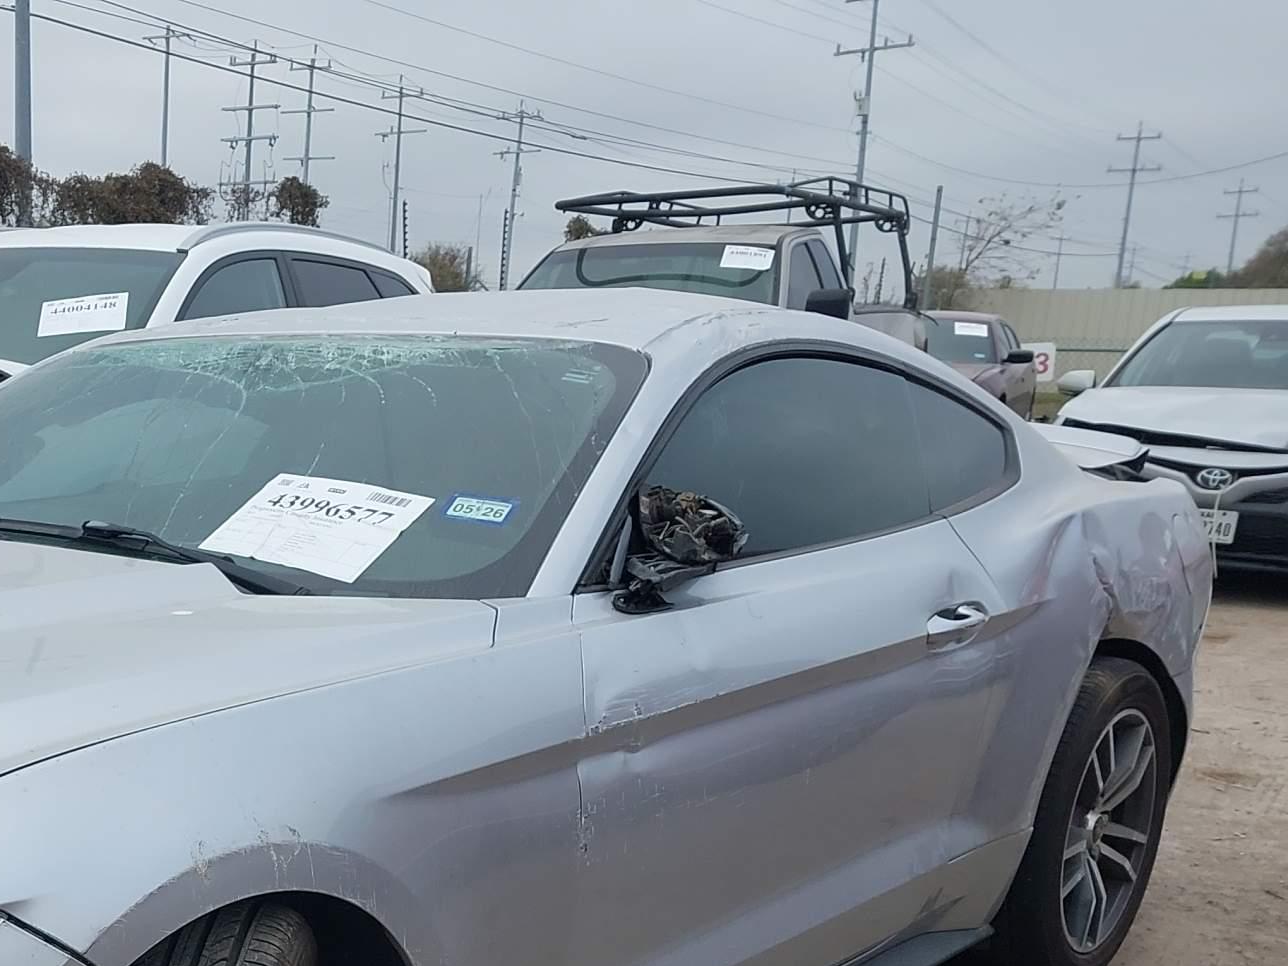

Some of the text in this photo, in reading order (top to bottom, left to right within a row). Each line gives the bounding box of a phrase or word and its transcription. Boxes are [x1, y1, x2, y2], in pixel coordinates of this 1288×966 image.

[1034, 352, 1049, 374] 3
[267, 493, 395, 526] 43996577
[452, 503, 505, 519] 05 26
